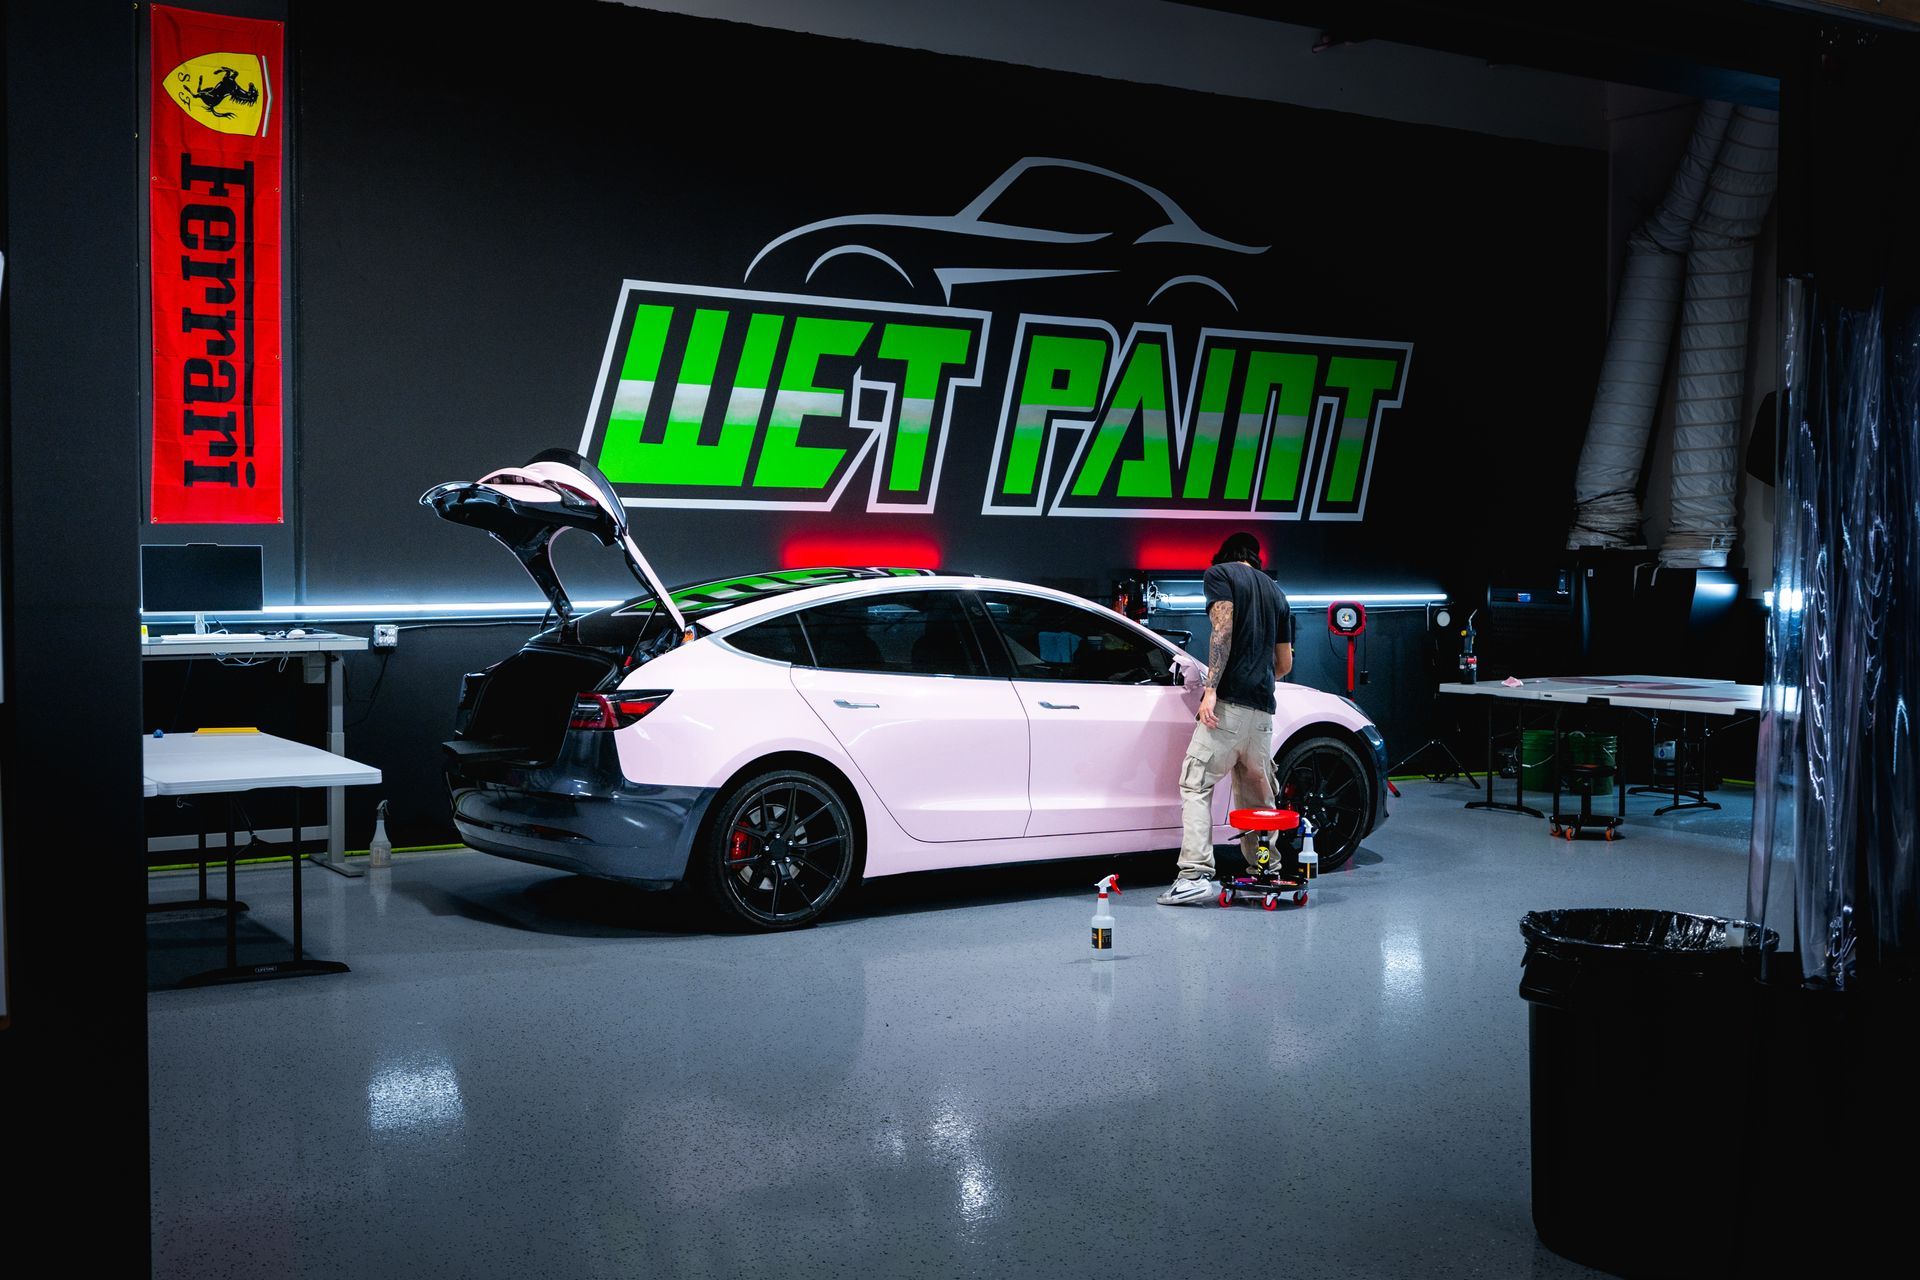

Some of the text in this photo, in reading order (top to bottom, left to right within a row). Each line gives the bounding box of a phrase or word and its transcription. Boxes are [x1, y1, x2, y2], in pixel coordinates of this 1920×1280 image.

[180, 152, 255, 488] Ferrari
[597, 303, 1399, 502] WET PAINT
